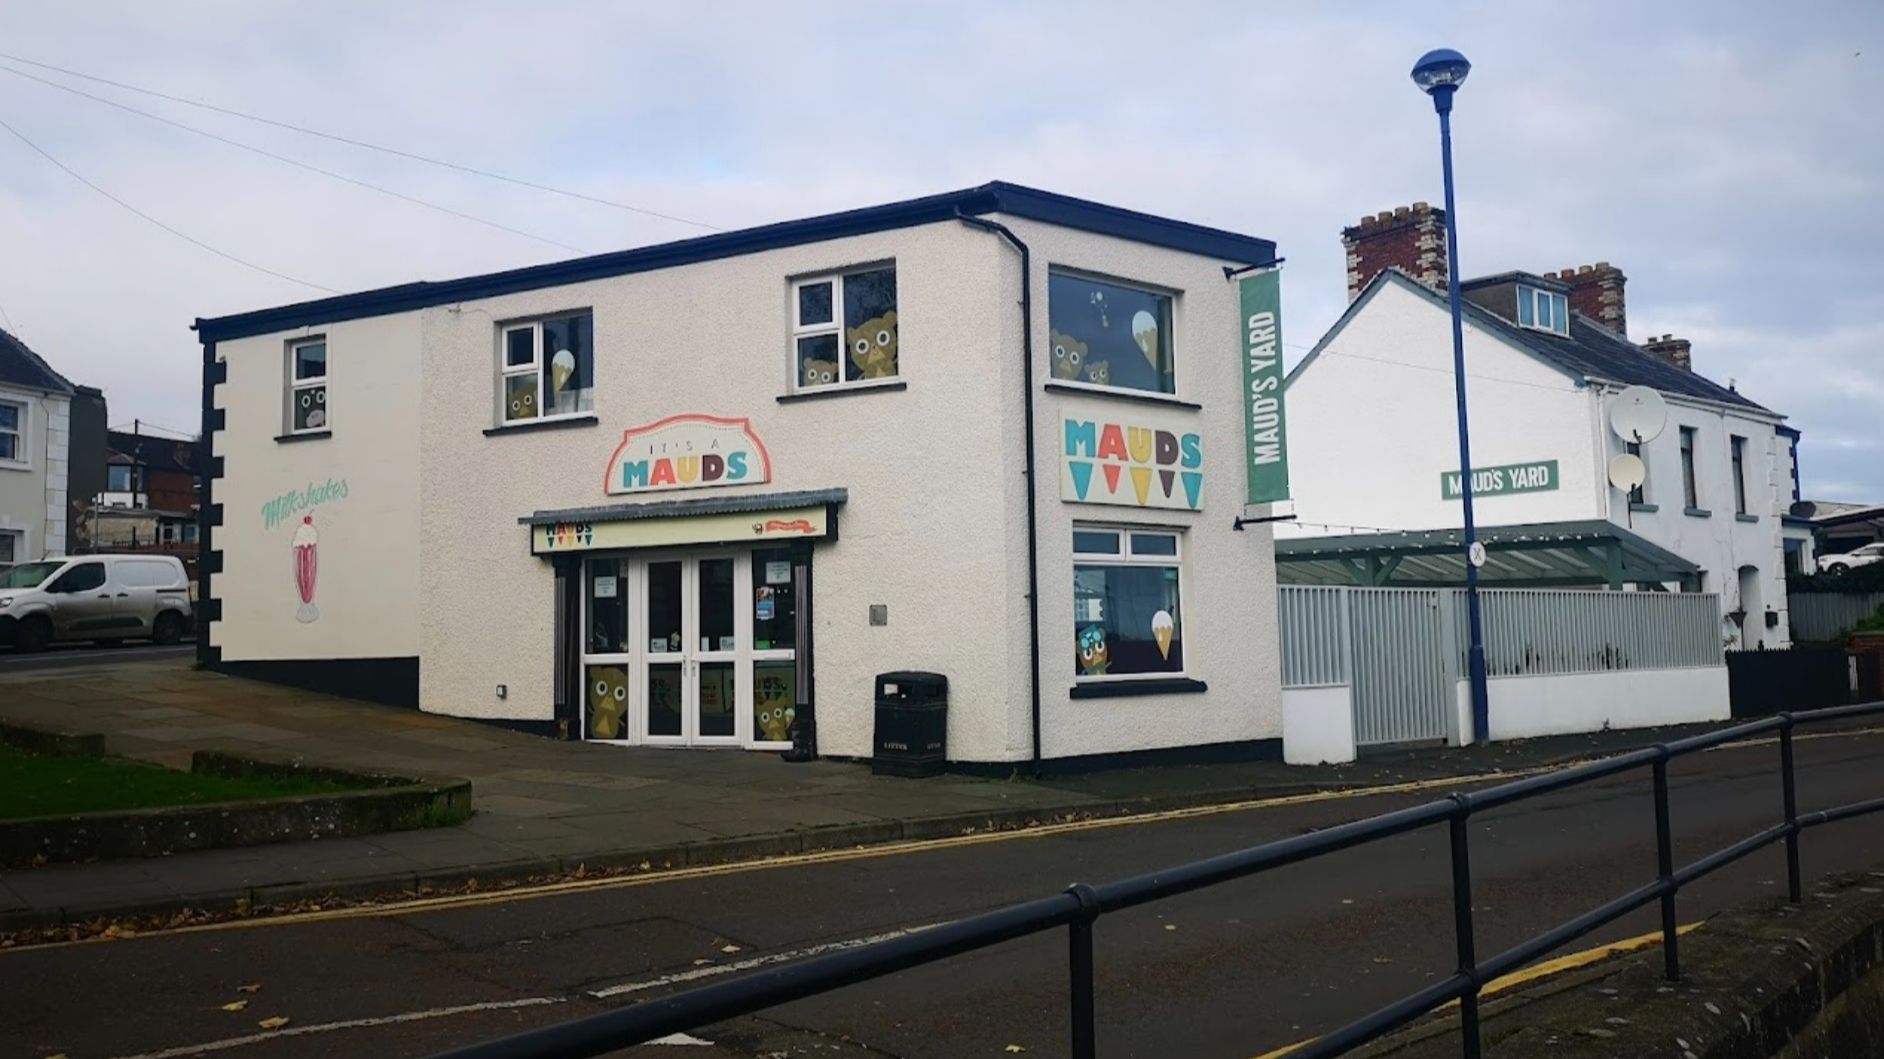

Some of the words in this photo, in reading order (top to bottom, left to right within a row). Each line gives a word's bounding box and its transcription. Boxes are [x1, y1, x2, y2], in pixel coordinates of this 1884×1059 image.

[1248, 310, 1277, 373] YARD
[1065, 418, 1202, 469] MAUDS
[1251, 376, 1280, 465] MAUD'S
[622, 451, 748, 488] MAUDS
[650, 440, 694, 455] IT'S
[711, 438, 720, 450] A
[1508, 465, 1550, 489] YARD
[260, 477, 349, 530] Milkshakes
